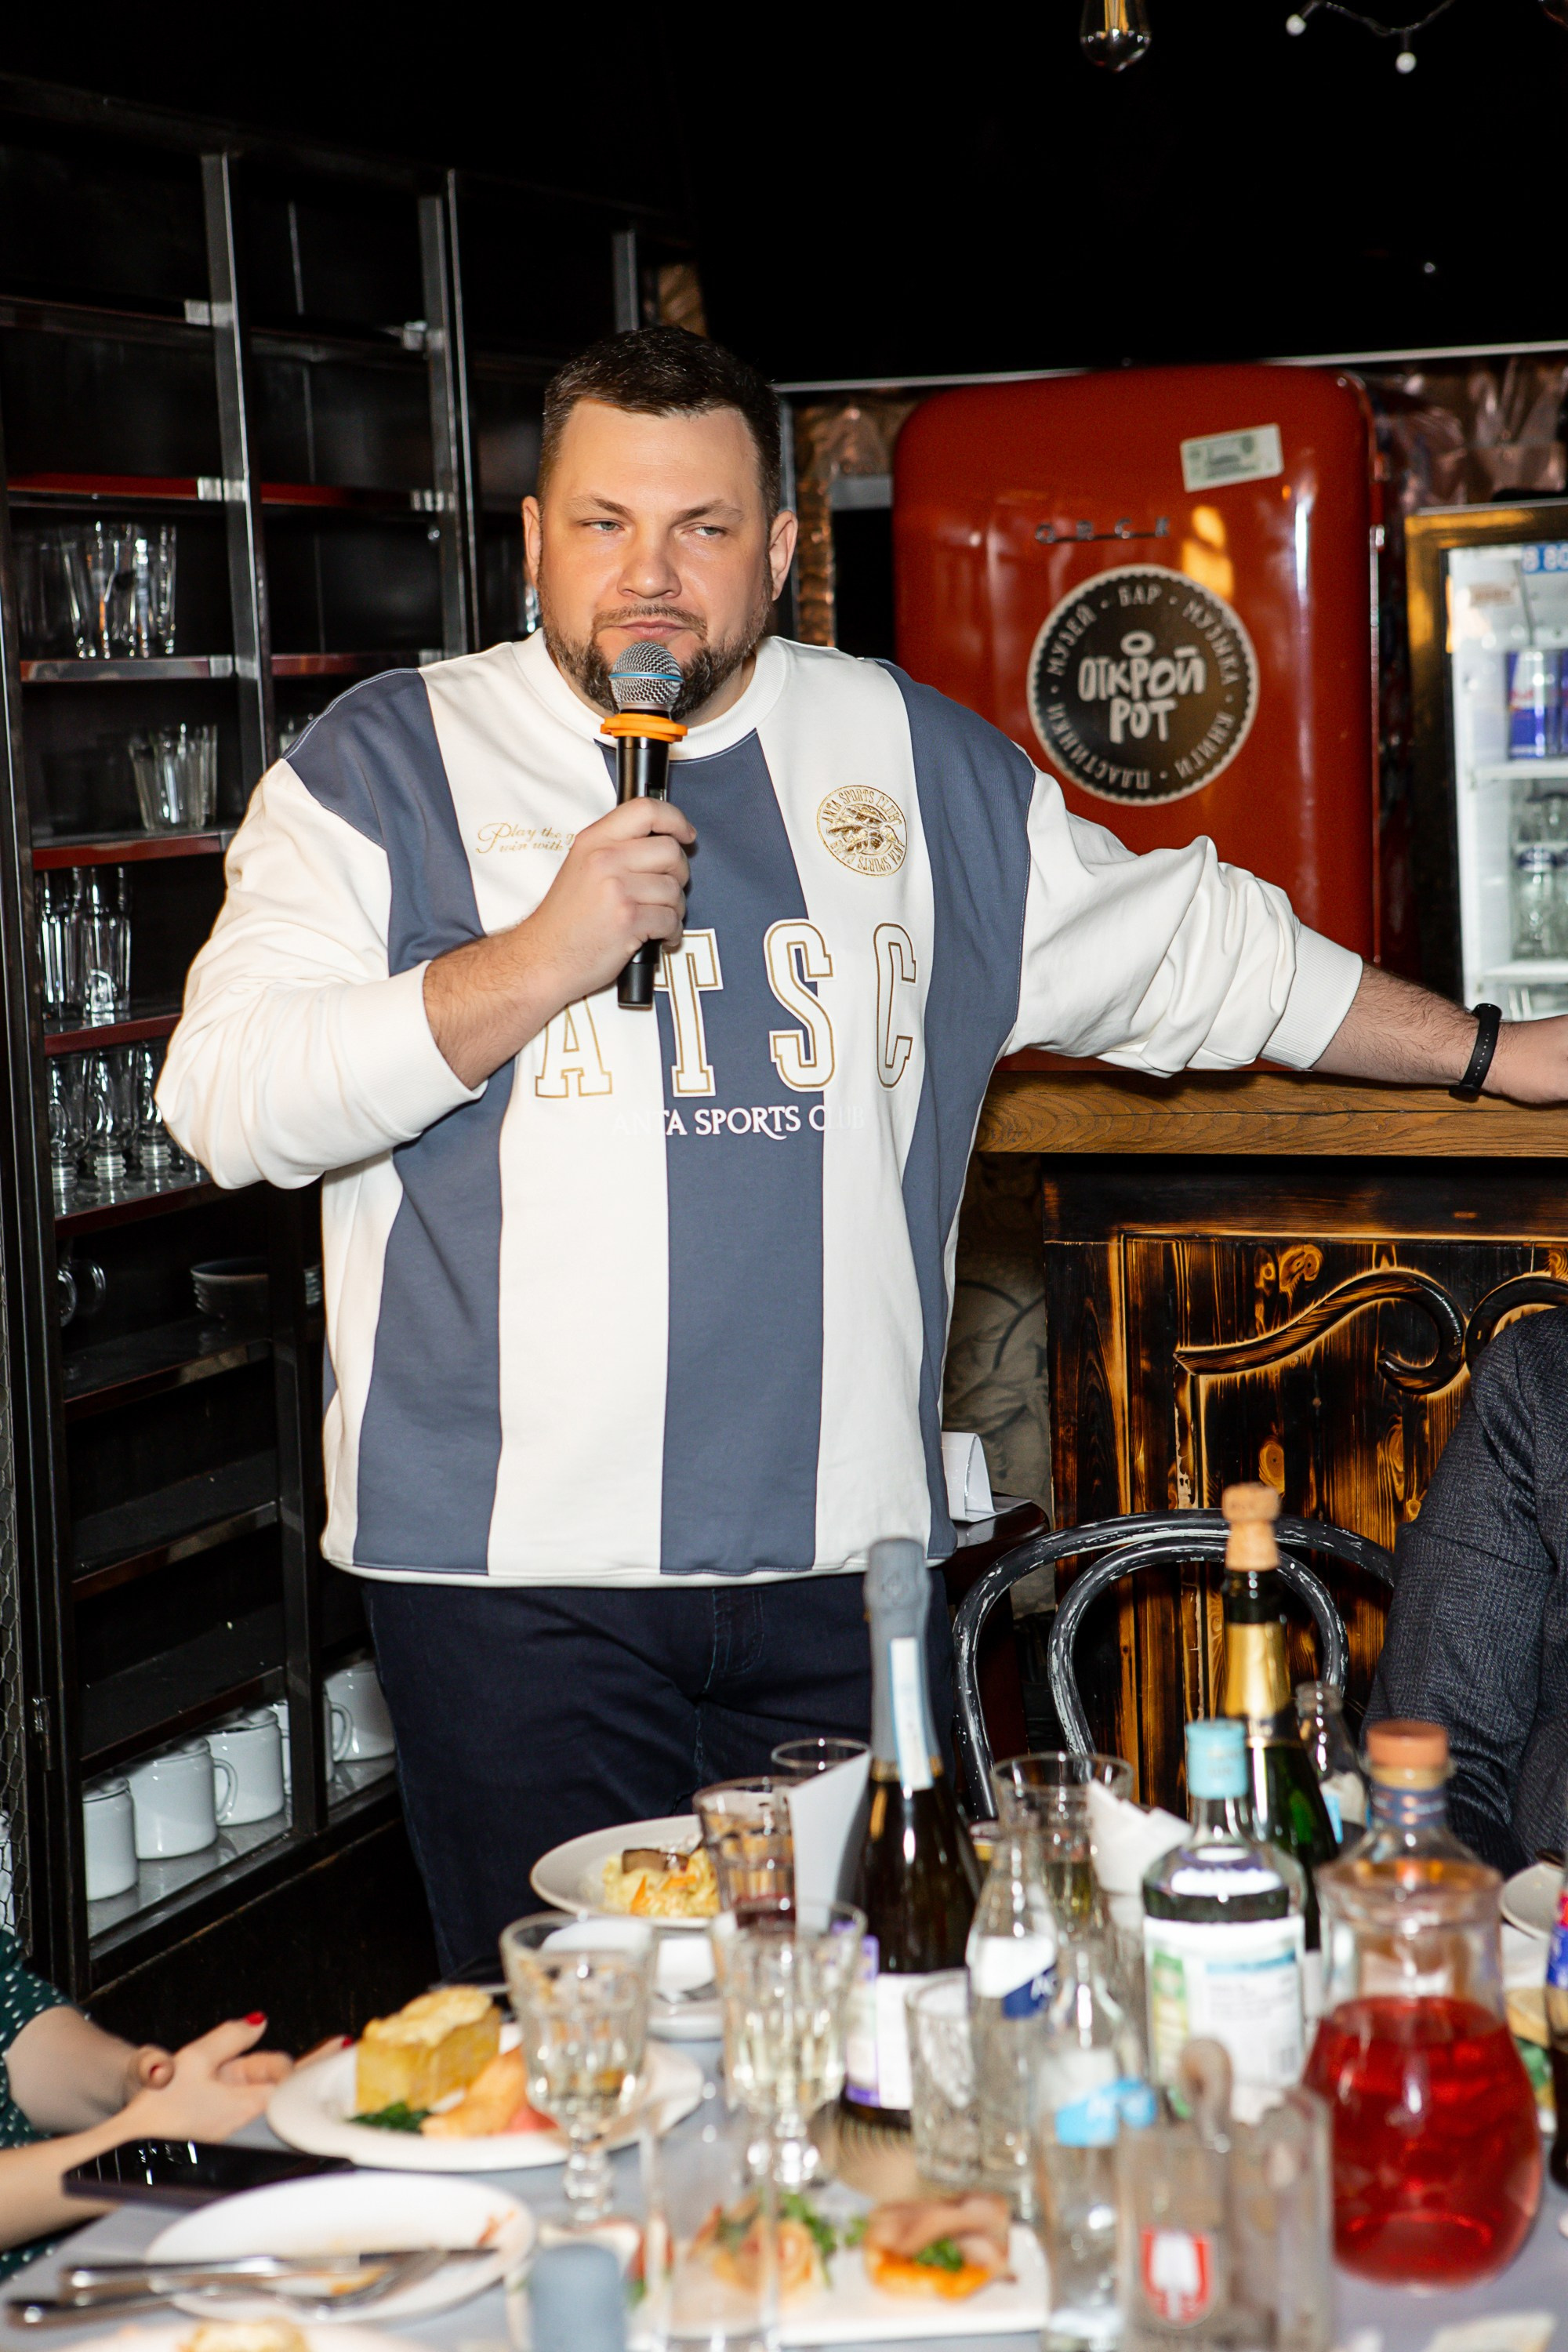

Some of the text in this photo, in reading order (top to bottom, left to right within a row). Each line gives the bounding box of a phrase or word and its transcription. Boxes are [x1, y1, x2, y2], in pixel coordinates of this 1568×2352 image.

[1047, 583, 1241, 789] МУЗЕЙ БАР МУЗЫКА КНИГИ ПЛАСТИНКИ
[1109, 697, 1178, 744] РОТ
[838, 788, 875, 804] SPORTS
[476, 822, 562, 853] Play the
[499, 841, 528, 853] win
[611, 1104, 863, 1141] ANTA SPORTS CLUB
